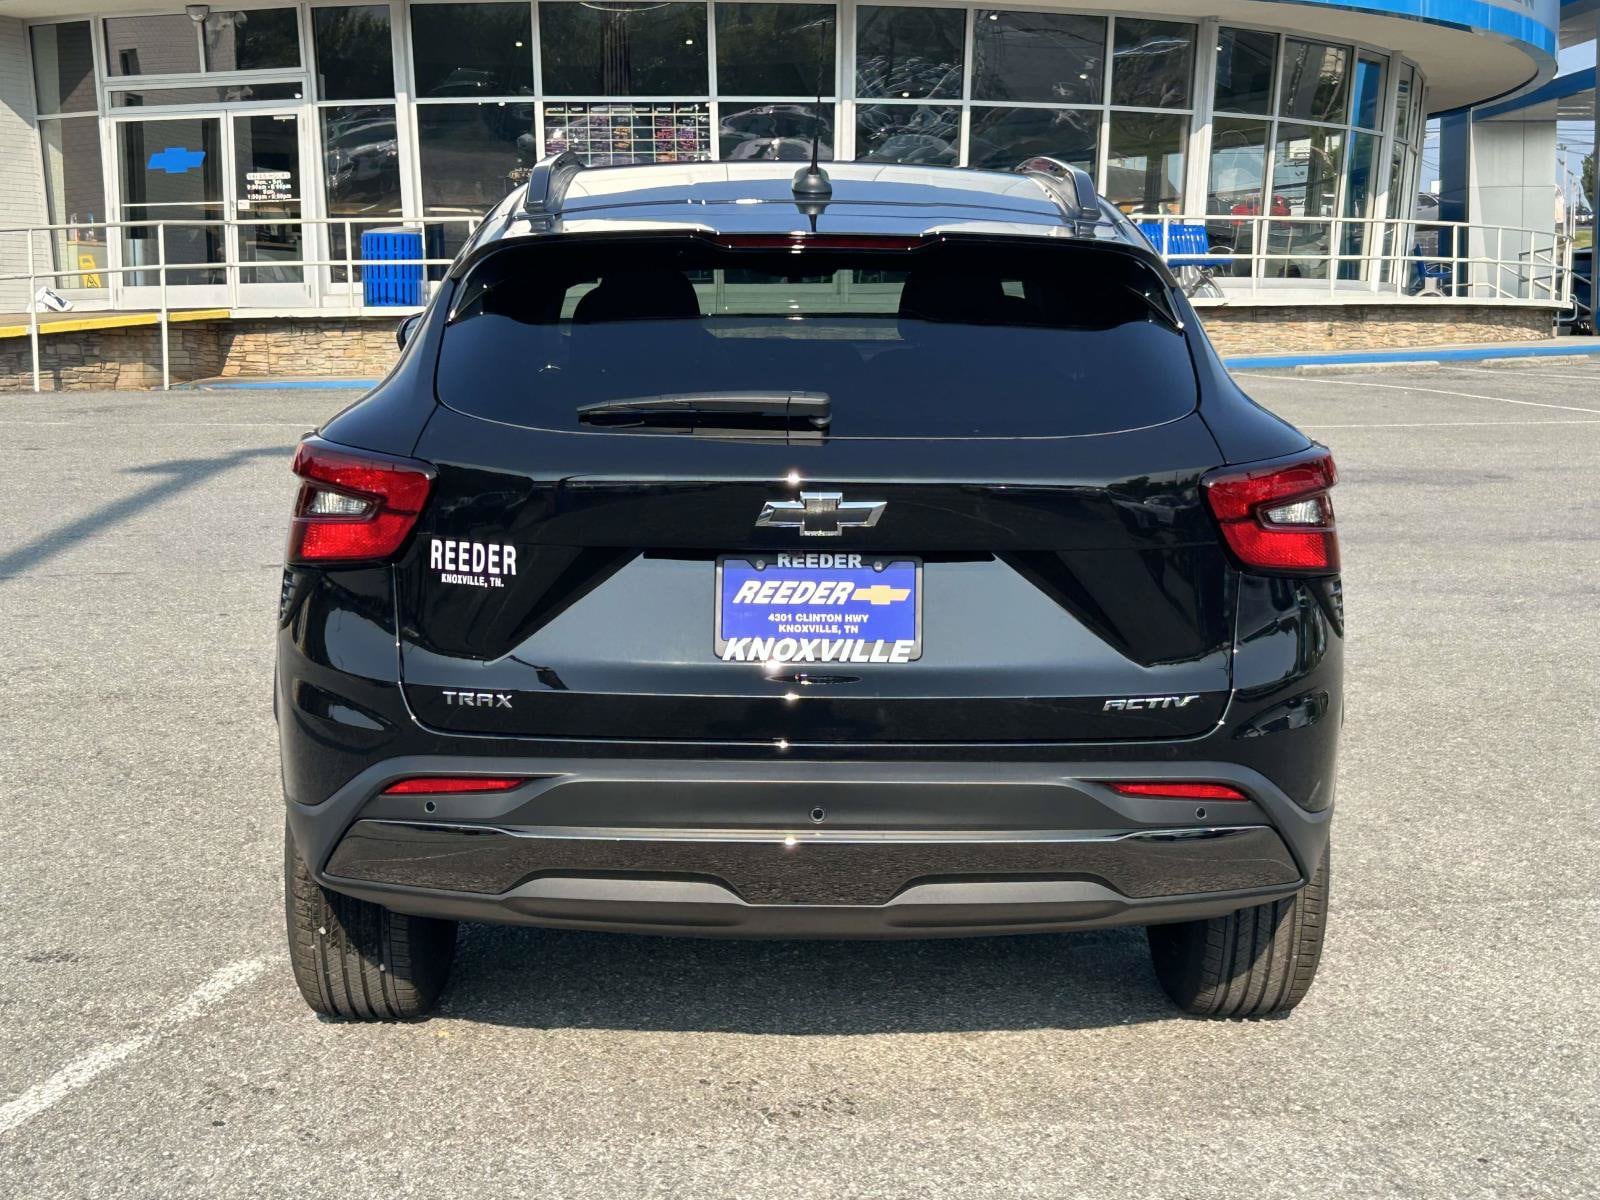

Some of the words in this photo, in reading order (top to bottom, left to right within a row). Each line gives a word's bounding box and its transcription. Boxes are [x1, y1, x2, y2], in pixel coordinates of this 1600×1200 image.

[430, 539, 517, 575] REEDER
[777, 553, 863, 569] REEDER
[441, 573, 488, 588] KNOXVILLE,
[489, 576, 505, 588] TN.
[732, 580, 856, 605] REEDER
[768, 613, 793, 623] 4301
[795, 613, 842, 623] CLINTON
[844, 613, 869, 623] HWY
[778, 624, 841, 635] KNOXVILLE,
[843, 624, 858, 634] TN
[721, 637, 915, 663] KNOXVILLE
[442, 691, 513, 709] TRAX
[1102, 694, 1200, 711] ACTIV
